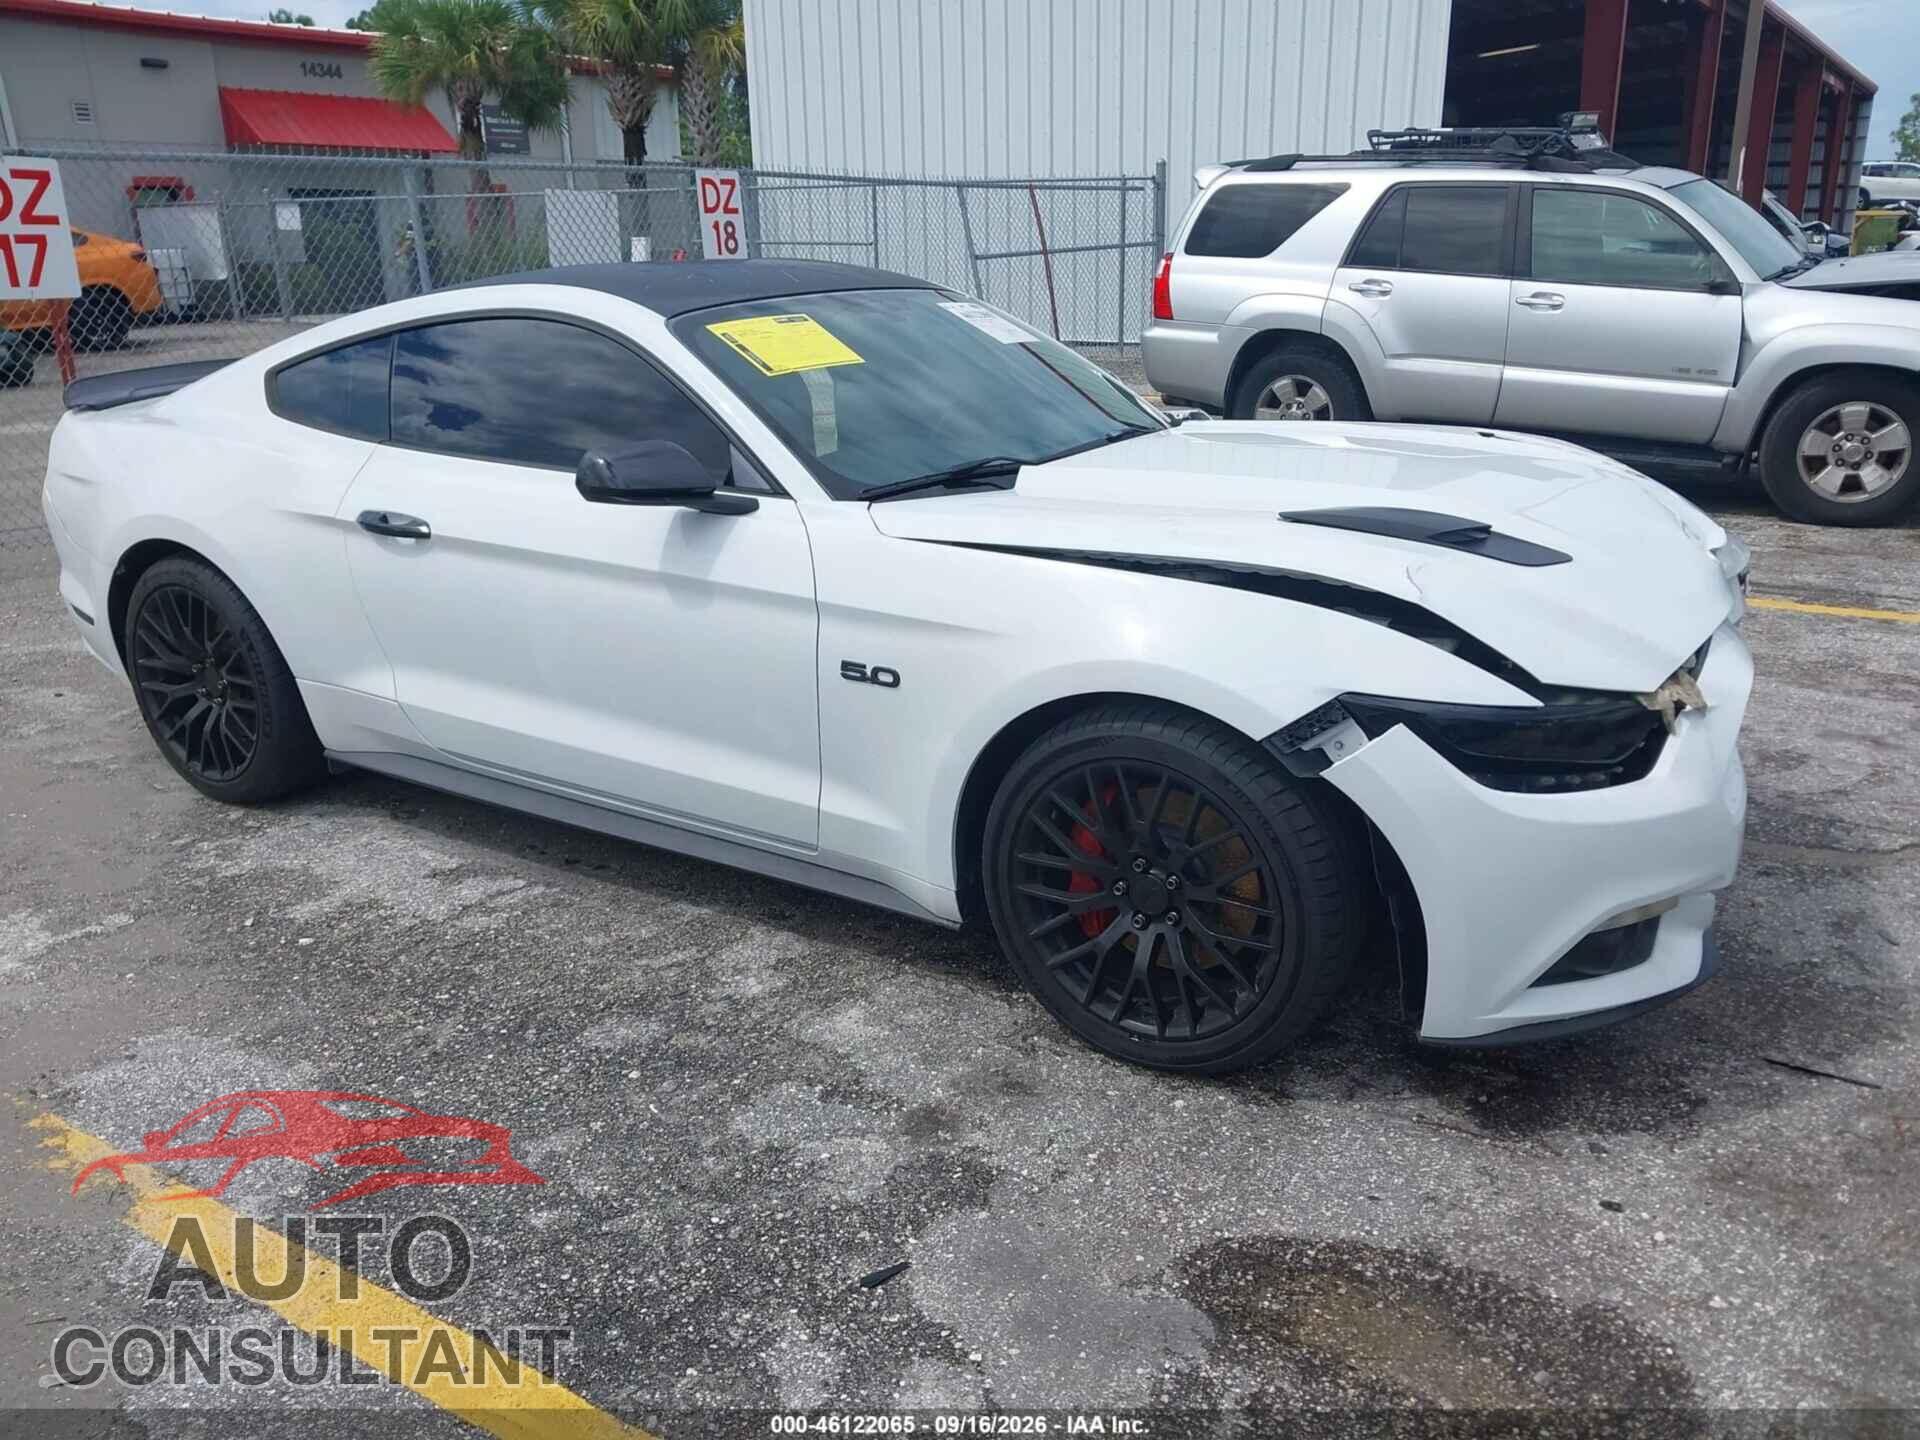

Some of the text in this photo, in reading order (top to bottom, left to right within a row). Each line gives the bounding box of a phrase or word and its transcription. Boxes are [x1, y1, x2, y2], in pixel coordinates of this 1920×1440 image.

[300, 61, 343, 79] 14344
[701, 176, 739, 214] DZ
[712, 220, 738, 255] 18
